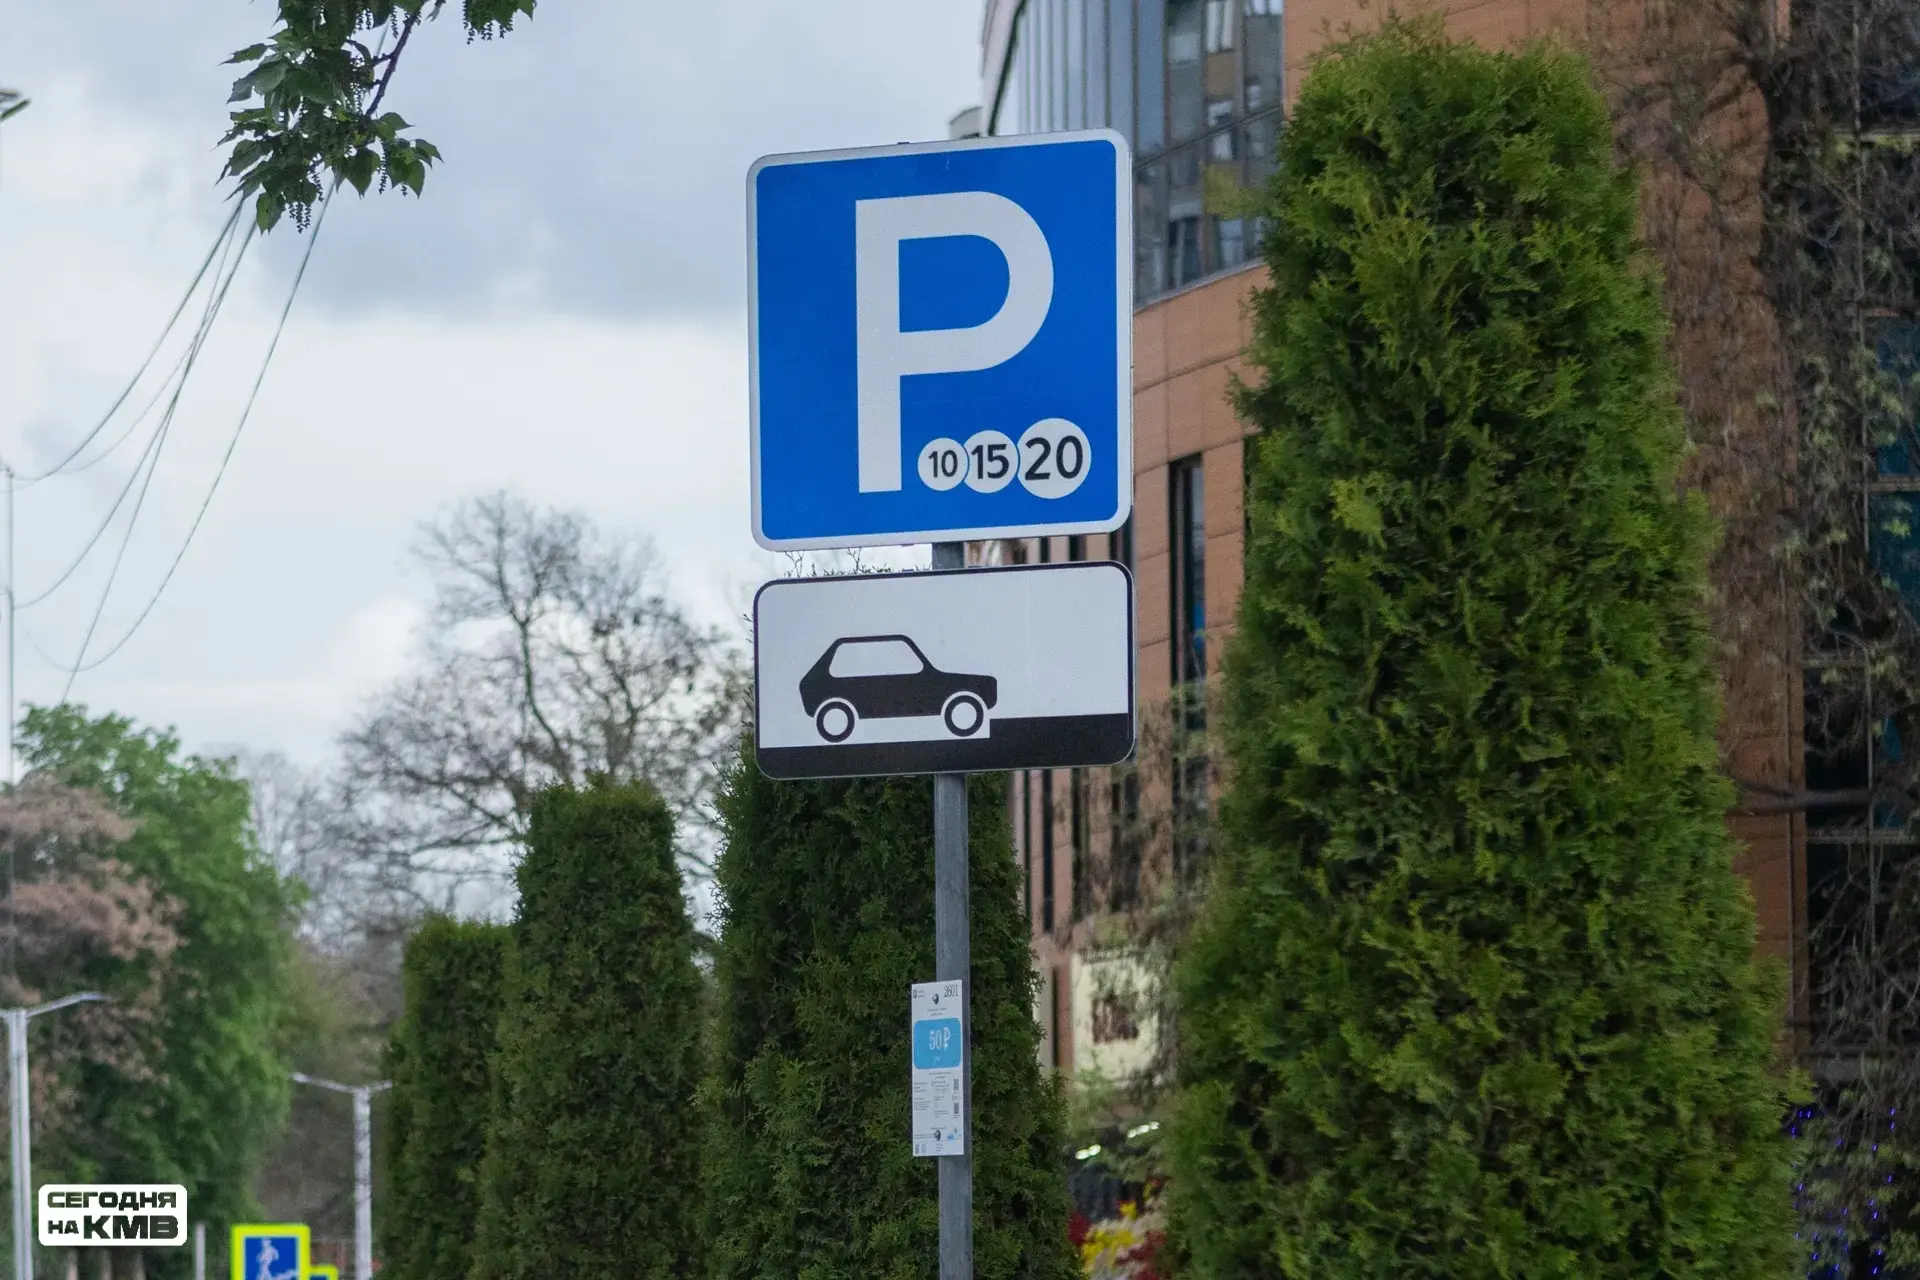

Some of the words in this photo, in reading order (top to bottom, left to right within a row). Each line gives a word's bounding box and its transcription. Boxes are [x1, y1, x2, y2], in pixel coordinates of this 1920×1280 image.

[855, 191, 1054, 493] P
[928, 450, 959, 478] 10
[971, 443, 1010, 480] 15
[1024, 435, 1084, 481] 20
